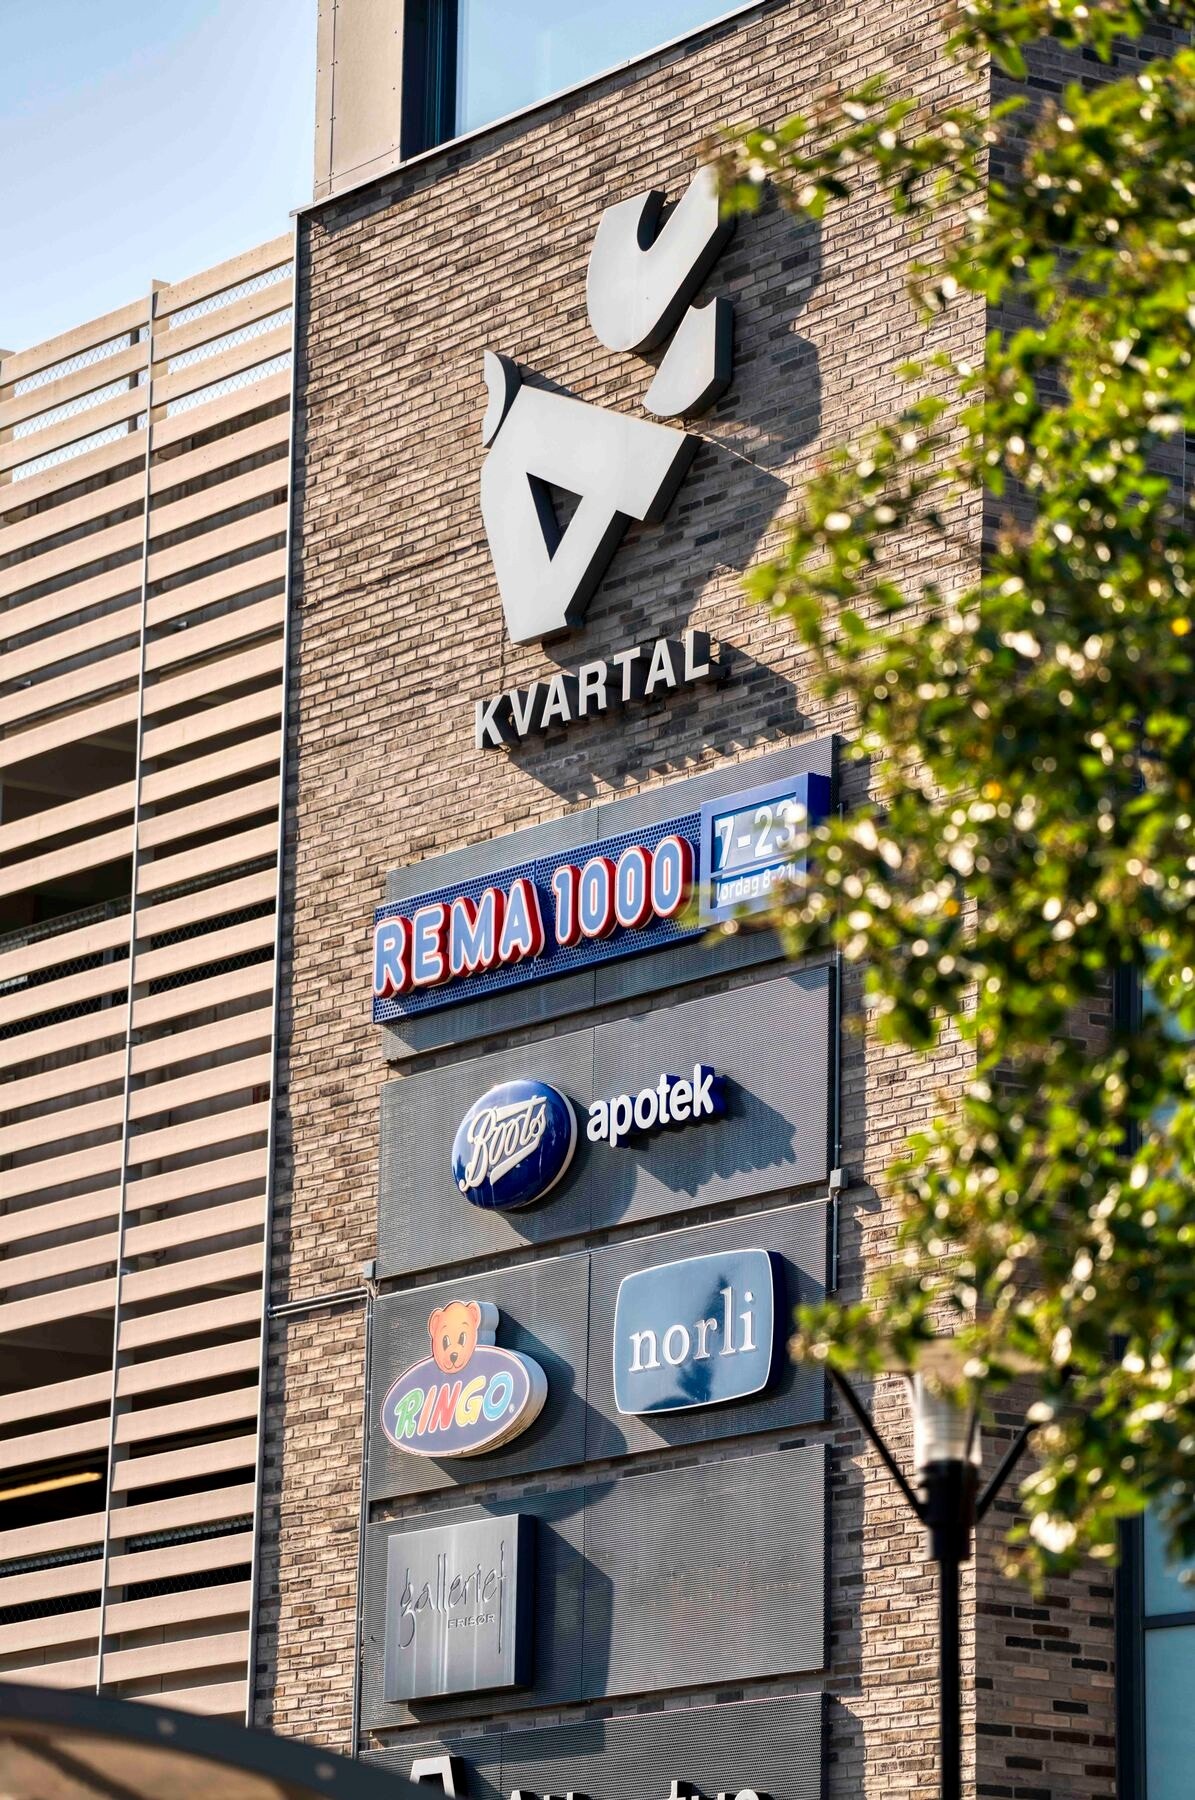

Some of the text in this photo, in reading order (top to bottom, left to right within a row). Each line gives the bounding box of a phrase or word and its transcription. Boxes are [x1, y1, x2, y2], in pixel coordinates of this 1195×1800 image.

[475, 629, 710, 750] KVARTAL
[373, 835, 694, 997] REMA 1000
[459, 1063, 714, 1192] Boots apotek
[629, 1287, 757, 1373] norli
[394, 1371, 513, 1440] RINGO
[398, 1540, 506, 1656] galleriet
